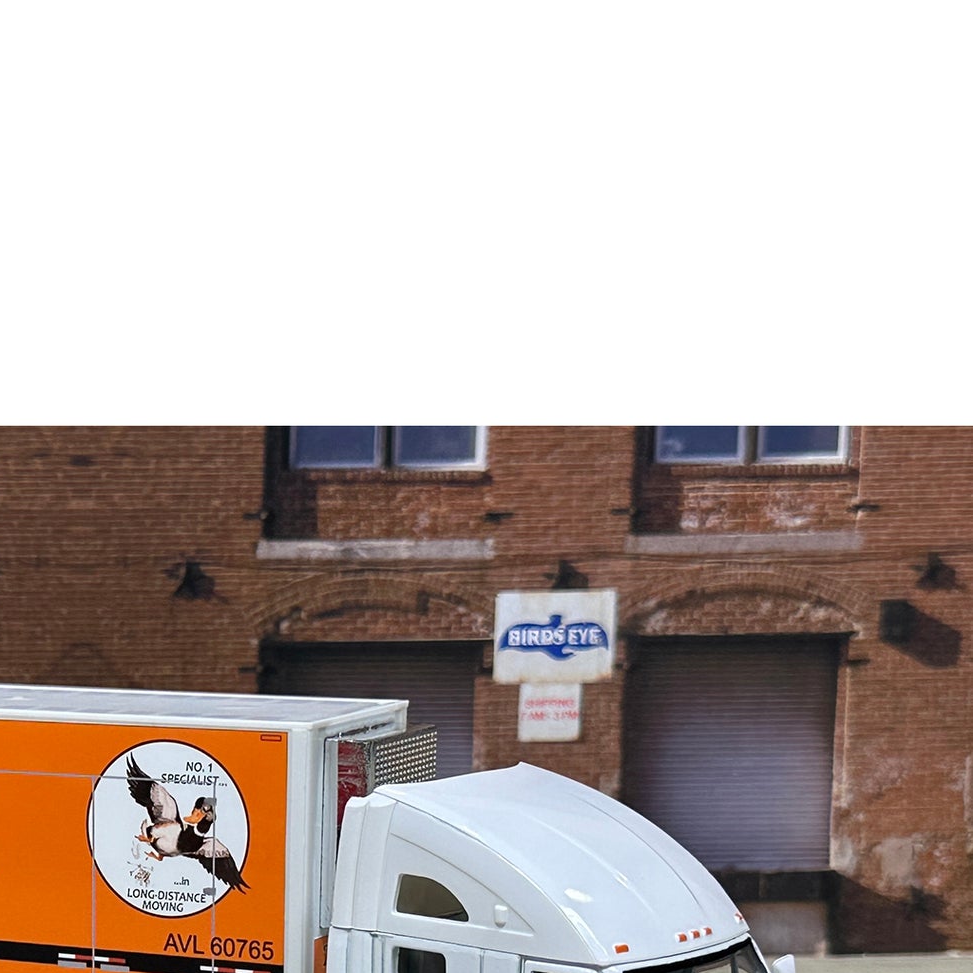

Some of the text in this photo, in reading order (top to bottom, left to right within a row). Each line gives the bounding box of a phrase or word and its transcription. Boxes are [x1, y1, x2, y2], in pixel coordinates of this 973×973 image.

[186, 761, 213, 773] NO. 1
[127, 888, 206, 903] LONG-DISTANCE
[142, 900, 184, 913] MOVING
[163, 933, 275, 961] AVL 60765
